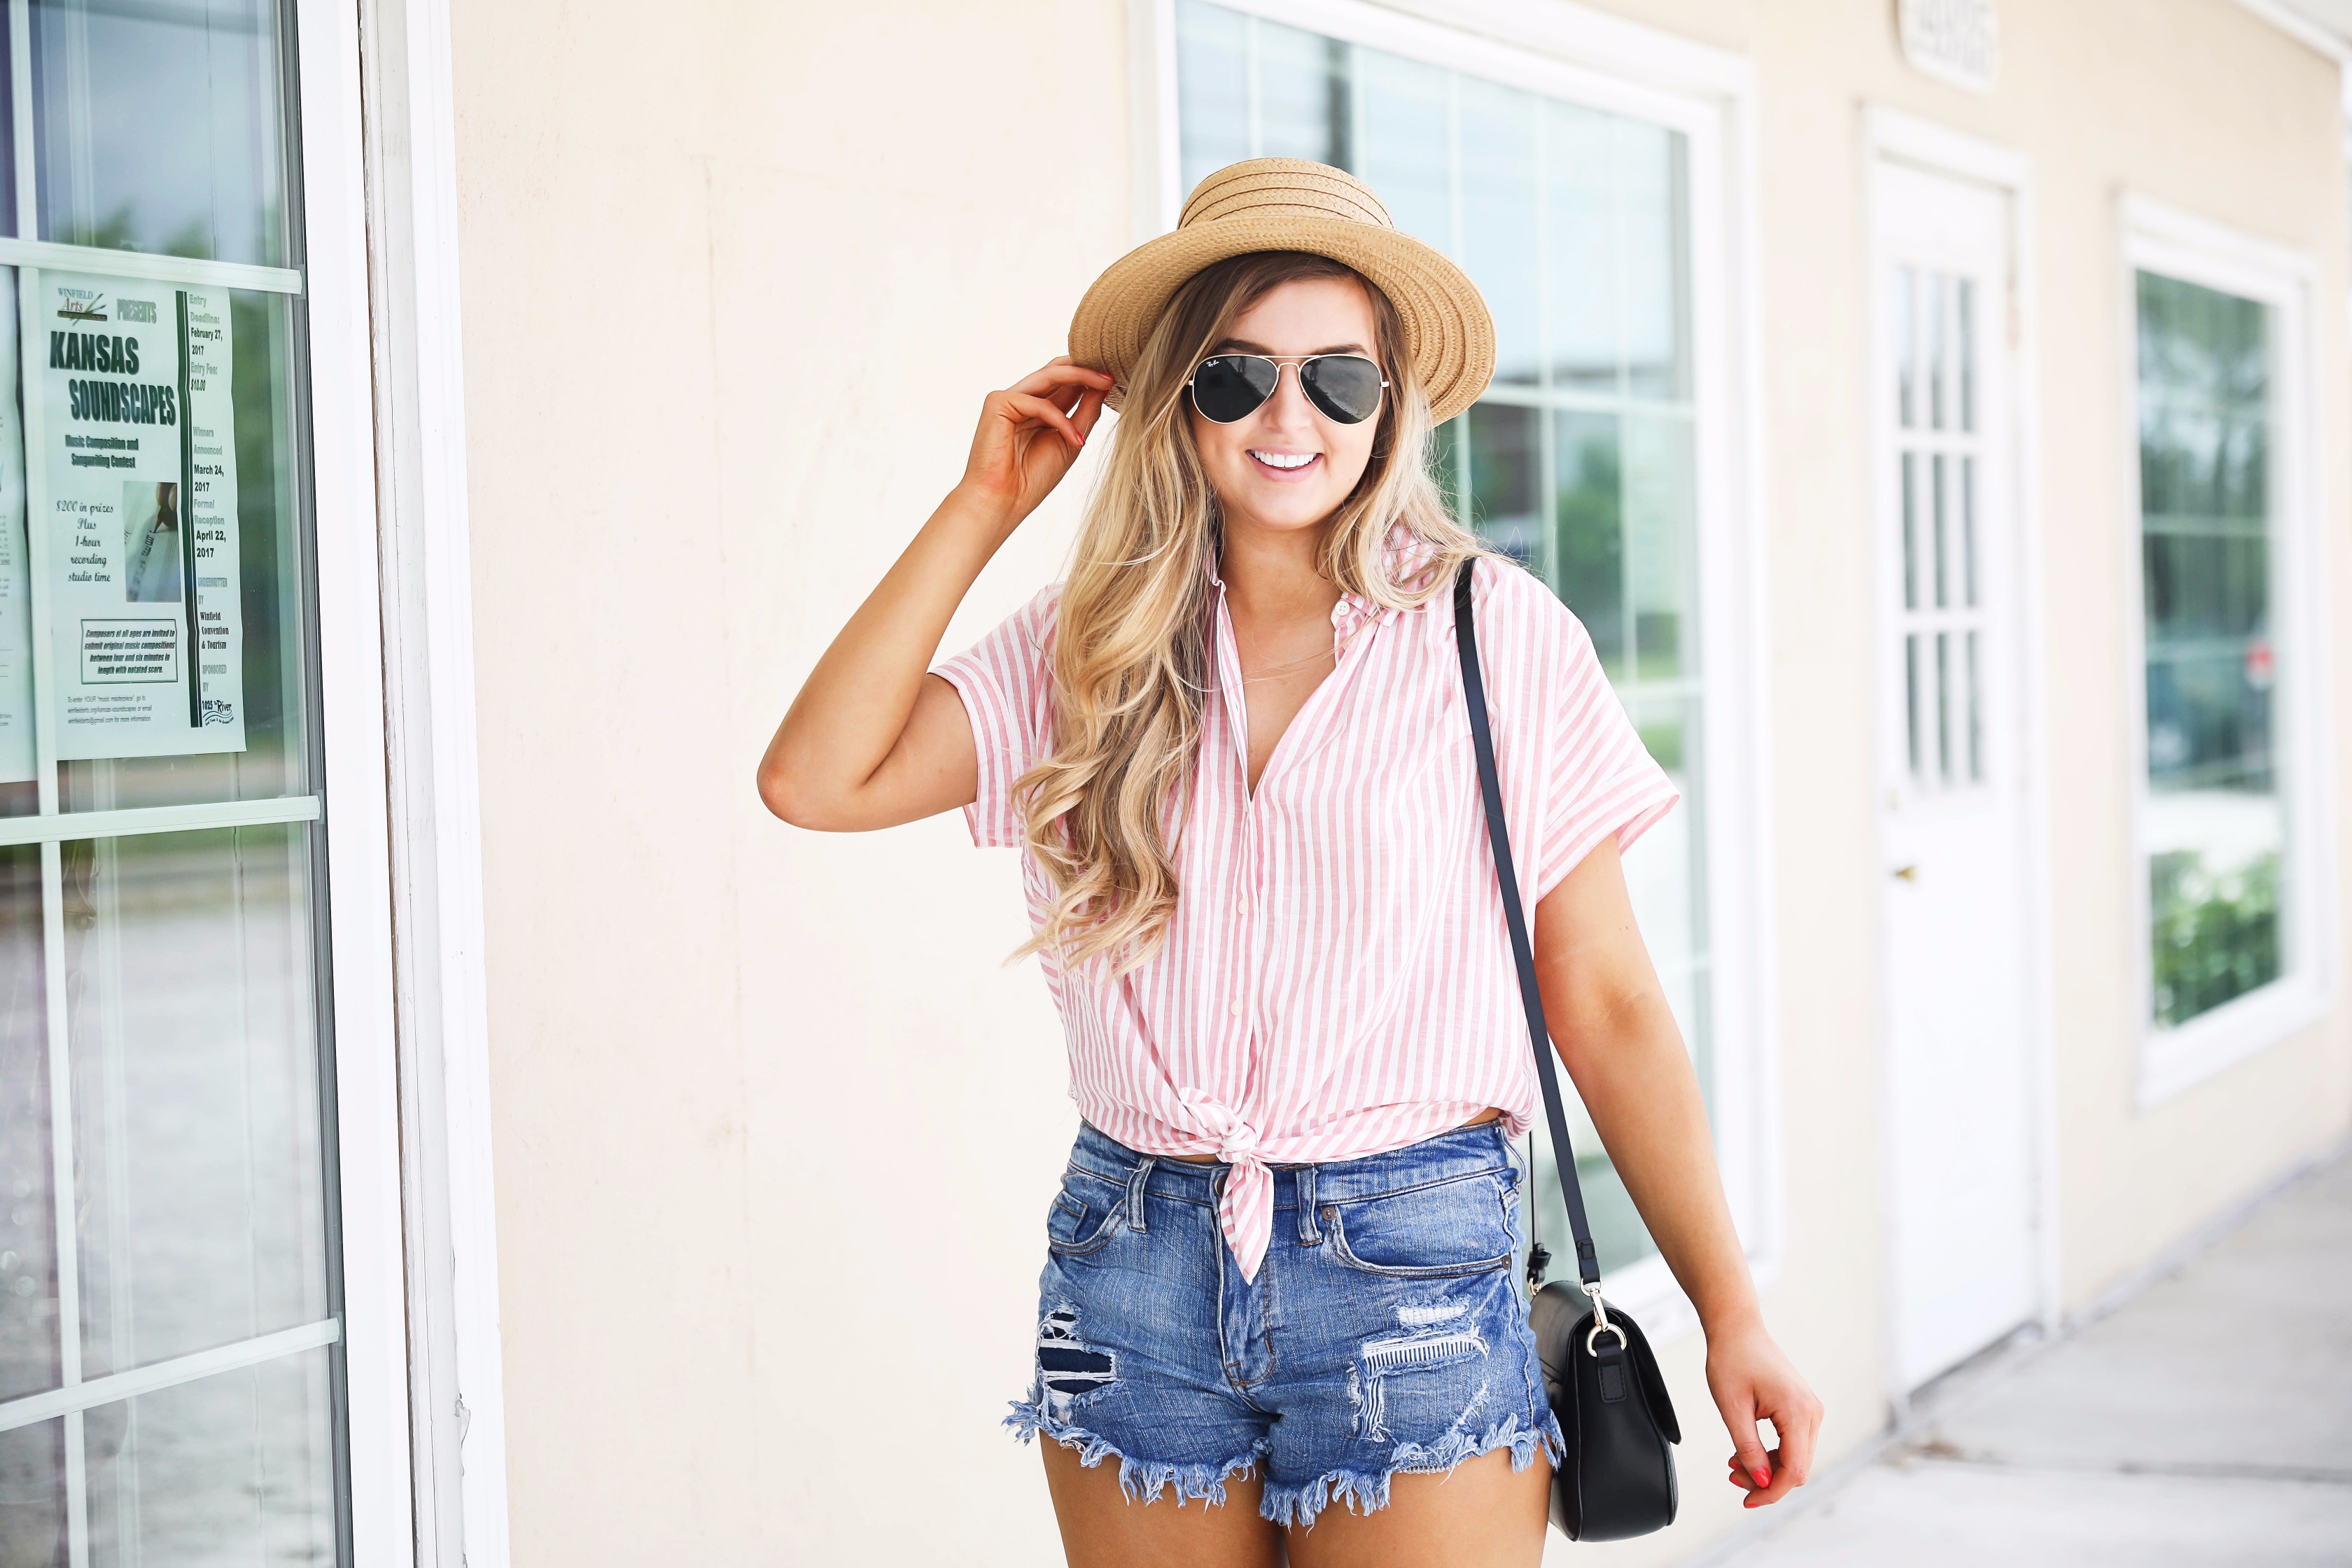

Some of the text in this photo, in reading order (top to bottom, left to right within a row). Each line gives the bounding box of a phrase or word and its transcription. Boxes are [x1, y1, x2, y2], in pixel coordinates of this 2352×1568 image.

[57, 288, 93, 300] WINFIELD
[62, 297, 83, 312] Arts
[189, 295, 206, 308] Entry
[117, 299, 157, 324] PRESENTS
[190, 312, 220, 324] Deadline:
[191, 328, 223, 342] February 27,
[50, 331, 139, 375] KANSAS
[192, 345, 204, 356] 2017
[190, 362, 218, 377] Entry Fee:
[190, 379, 206, 391] $10.00
[69, 379, 176, 426] SOUNDSCAPES
[193, 426, 214, 438] Winners
[65, 435, 139, 450] Music Composition and
[193, 444, 223, 456] Announced
[71, 453, 136, 468] Songwriting Contest
[194, 464, 224, 477] March 24,
[194, 482, 210, 492] 2017
[79, 503, 88, 512] in
[90, 503, 114, 516] prizes
[193, 499, 215, 510] Formal
[77, 518, 97, 530] Plus
[194, 515, 225, 526] Reception
[76, 536, 101, 547] 1-hour
[196, 531, 226, 543] April 22,
[197, 548, 214, 558] 2017
[71, 553, 107, 568] recording
[68, 570, 111, 582] studio time
[198, 595, 204, 605] BY
[200, 612, 221, 621] Winfield
[85, 630, 115, 638] Composers
[129, 630, 142, 638] ages
[151, 629, 169, 638] invited
[202, 626, 229, 635] Convention
[104, 642, 125, 650] original
[141, 641, 176, 650] compositions
[202, 640, 227, 650] & Tourism
[90, 654, 113, 662] between
[97, 666, 115, 675] length
[202, 664, 227, 675] SPONSORED
[203, 682, 209, 692] BY
[216, 699, 232, 713] River
